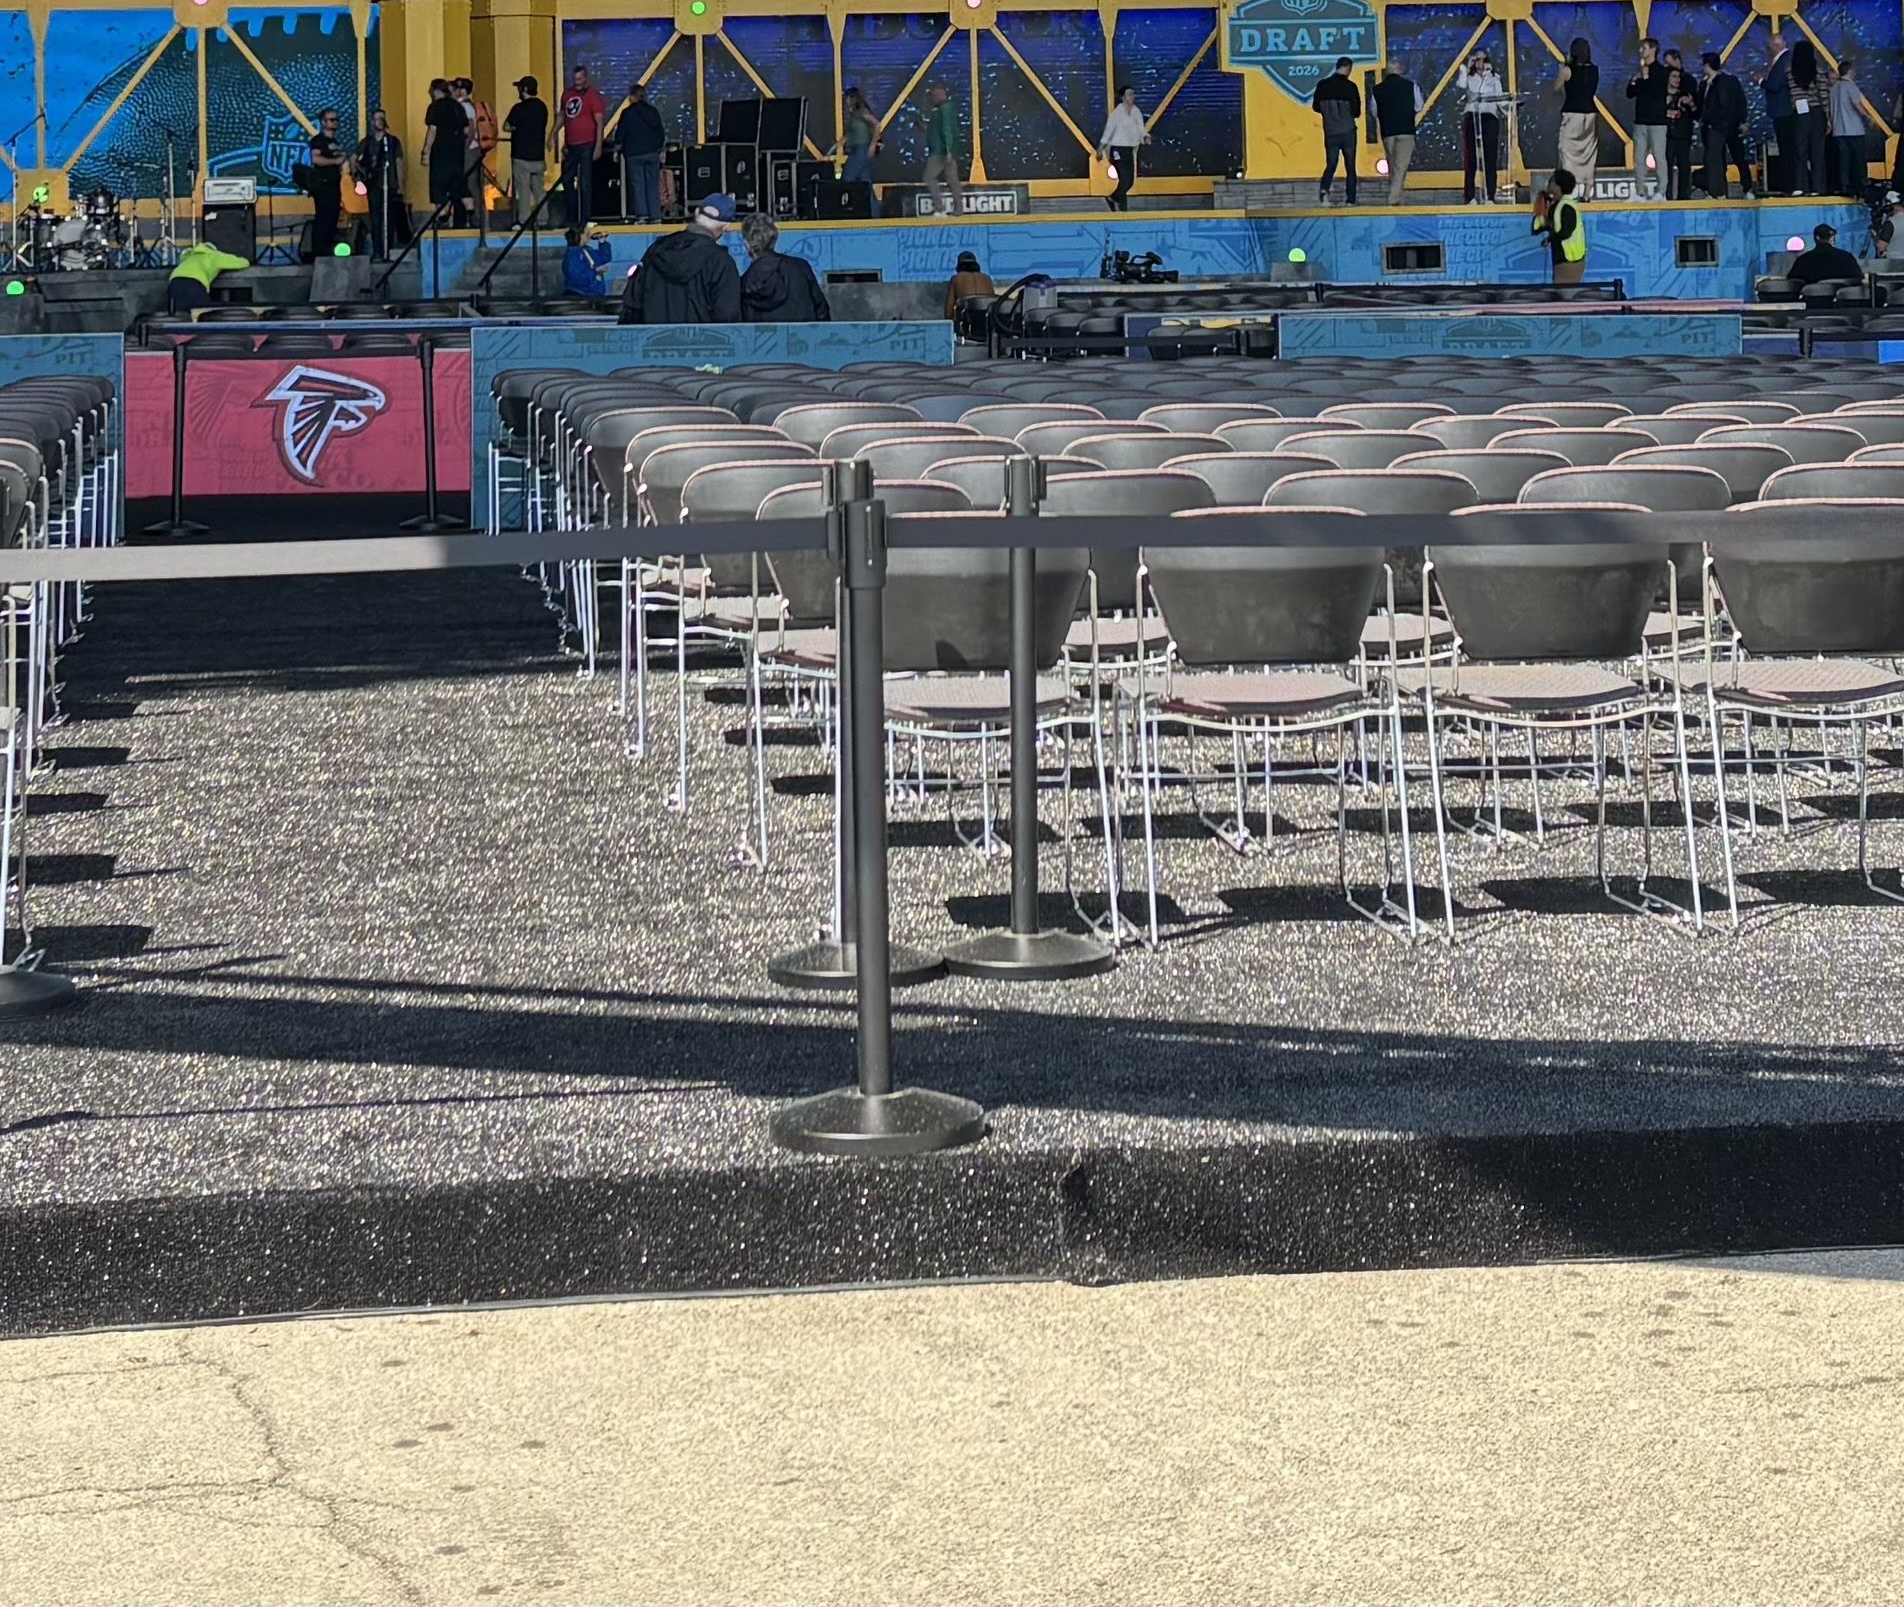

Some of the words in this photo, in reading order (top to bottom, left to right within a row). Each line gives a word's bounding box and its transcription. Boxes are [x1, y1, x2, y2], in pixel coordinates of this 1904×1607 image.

[1239, 27, 1366, 53] DRAFT
[1287, 65, 1321, 77] 2026
[961, 195, 1013, 213] LIGHT
[889, 338, 920, 351] PIT
[55, 352, 87, 365] PIT
